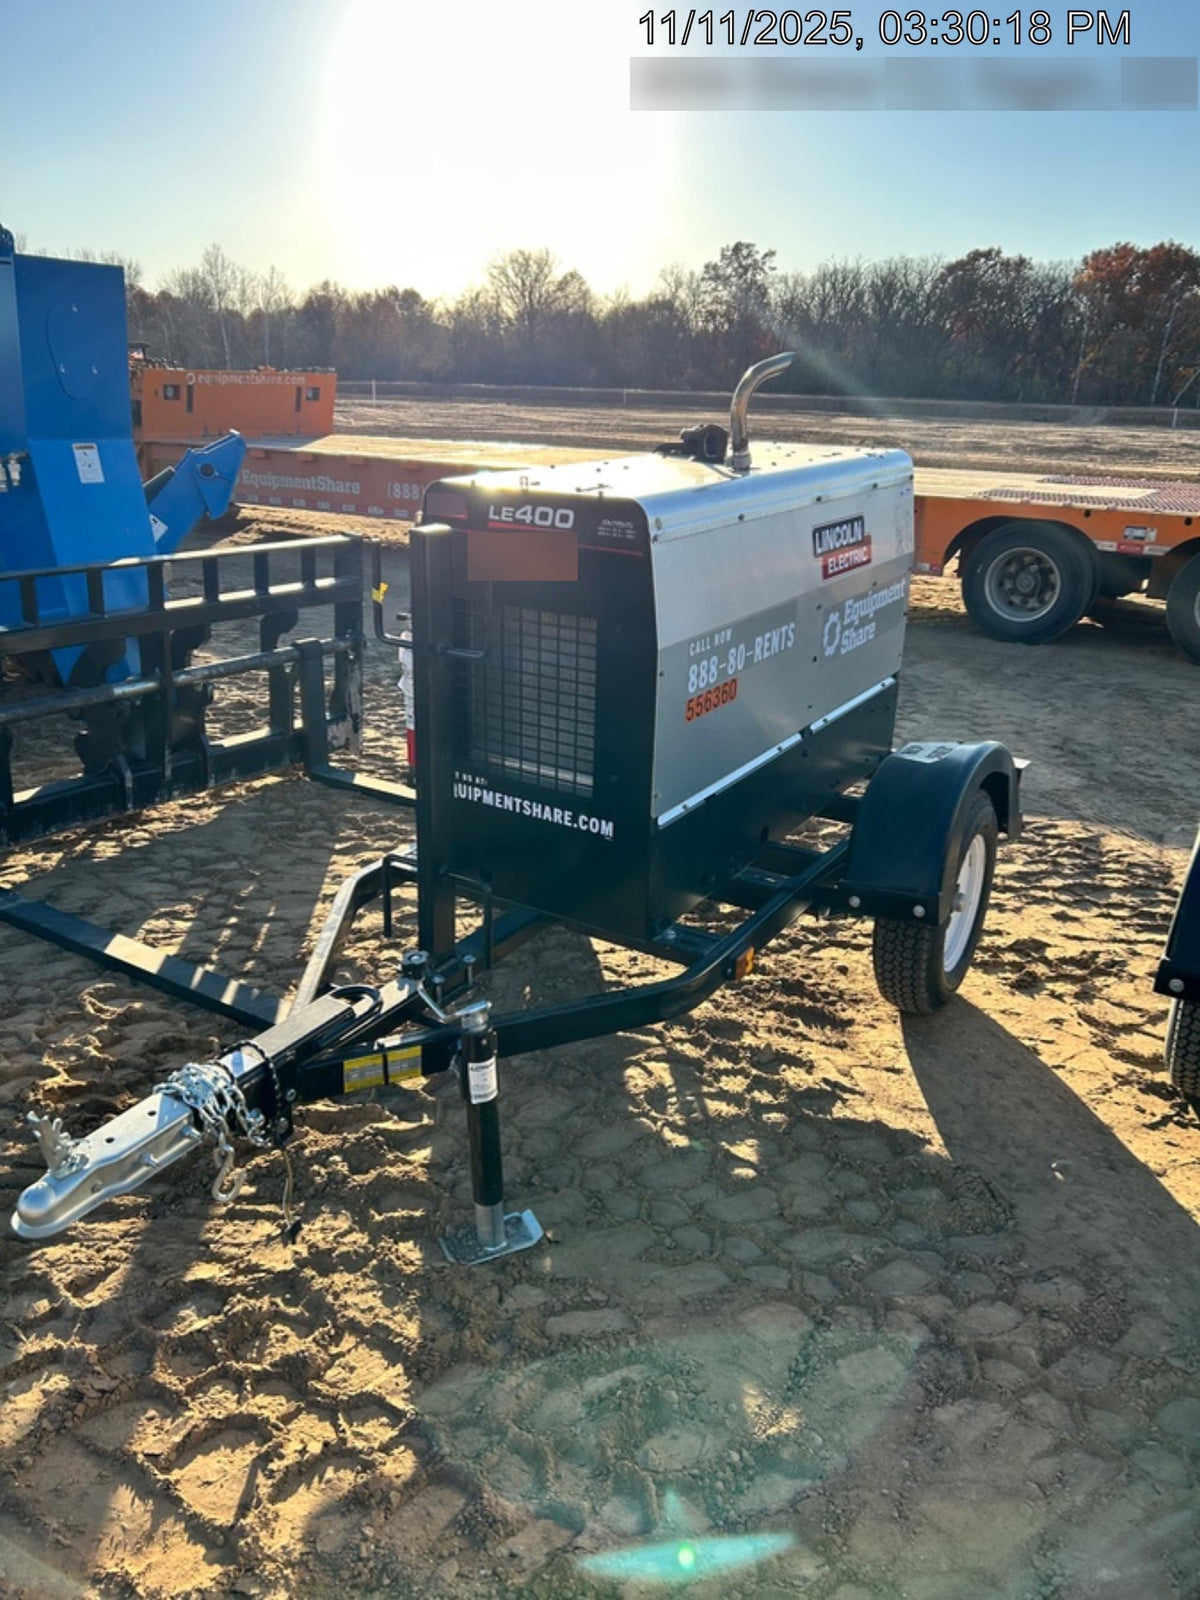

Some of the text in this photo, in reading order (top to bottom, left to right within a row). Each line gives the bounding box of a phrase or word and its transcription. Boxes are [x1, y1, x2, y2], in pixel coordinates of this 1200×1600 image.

[242, 469, 424, 500] EquipmentShare (888
[488, 504, 575, 529] LE400
[814, 518, 864, 554] LINCOLN
[827, 546, 869, 574] ELECTRIC
[843, 577, 907, 626] Equipment
[689, 636, 711, 657] CALL
[840, 621, 877, 656] Share
[687, 621, 796, 693] 888-80-RENTS
[686, 678, 738, 722] 556360
